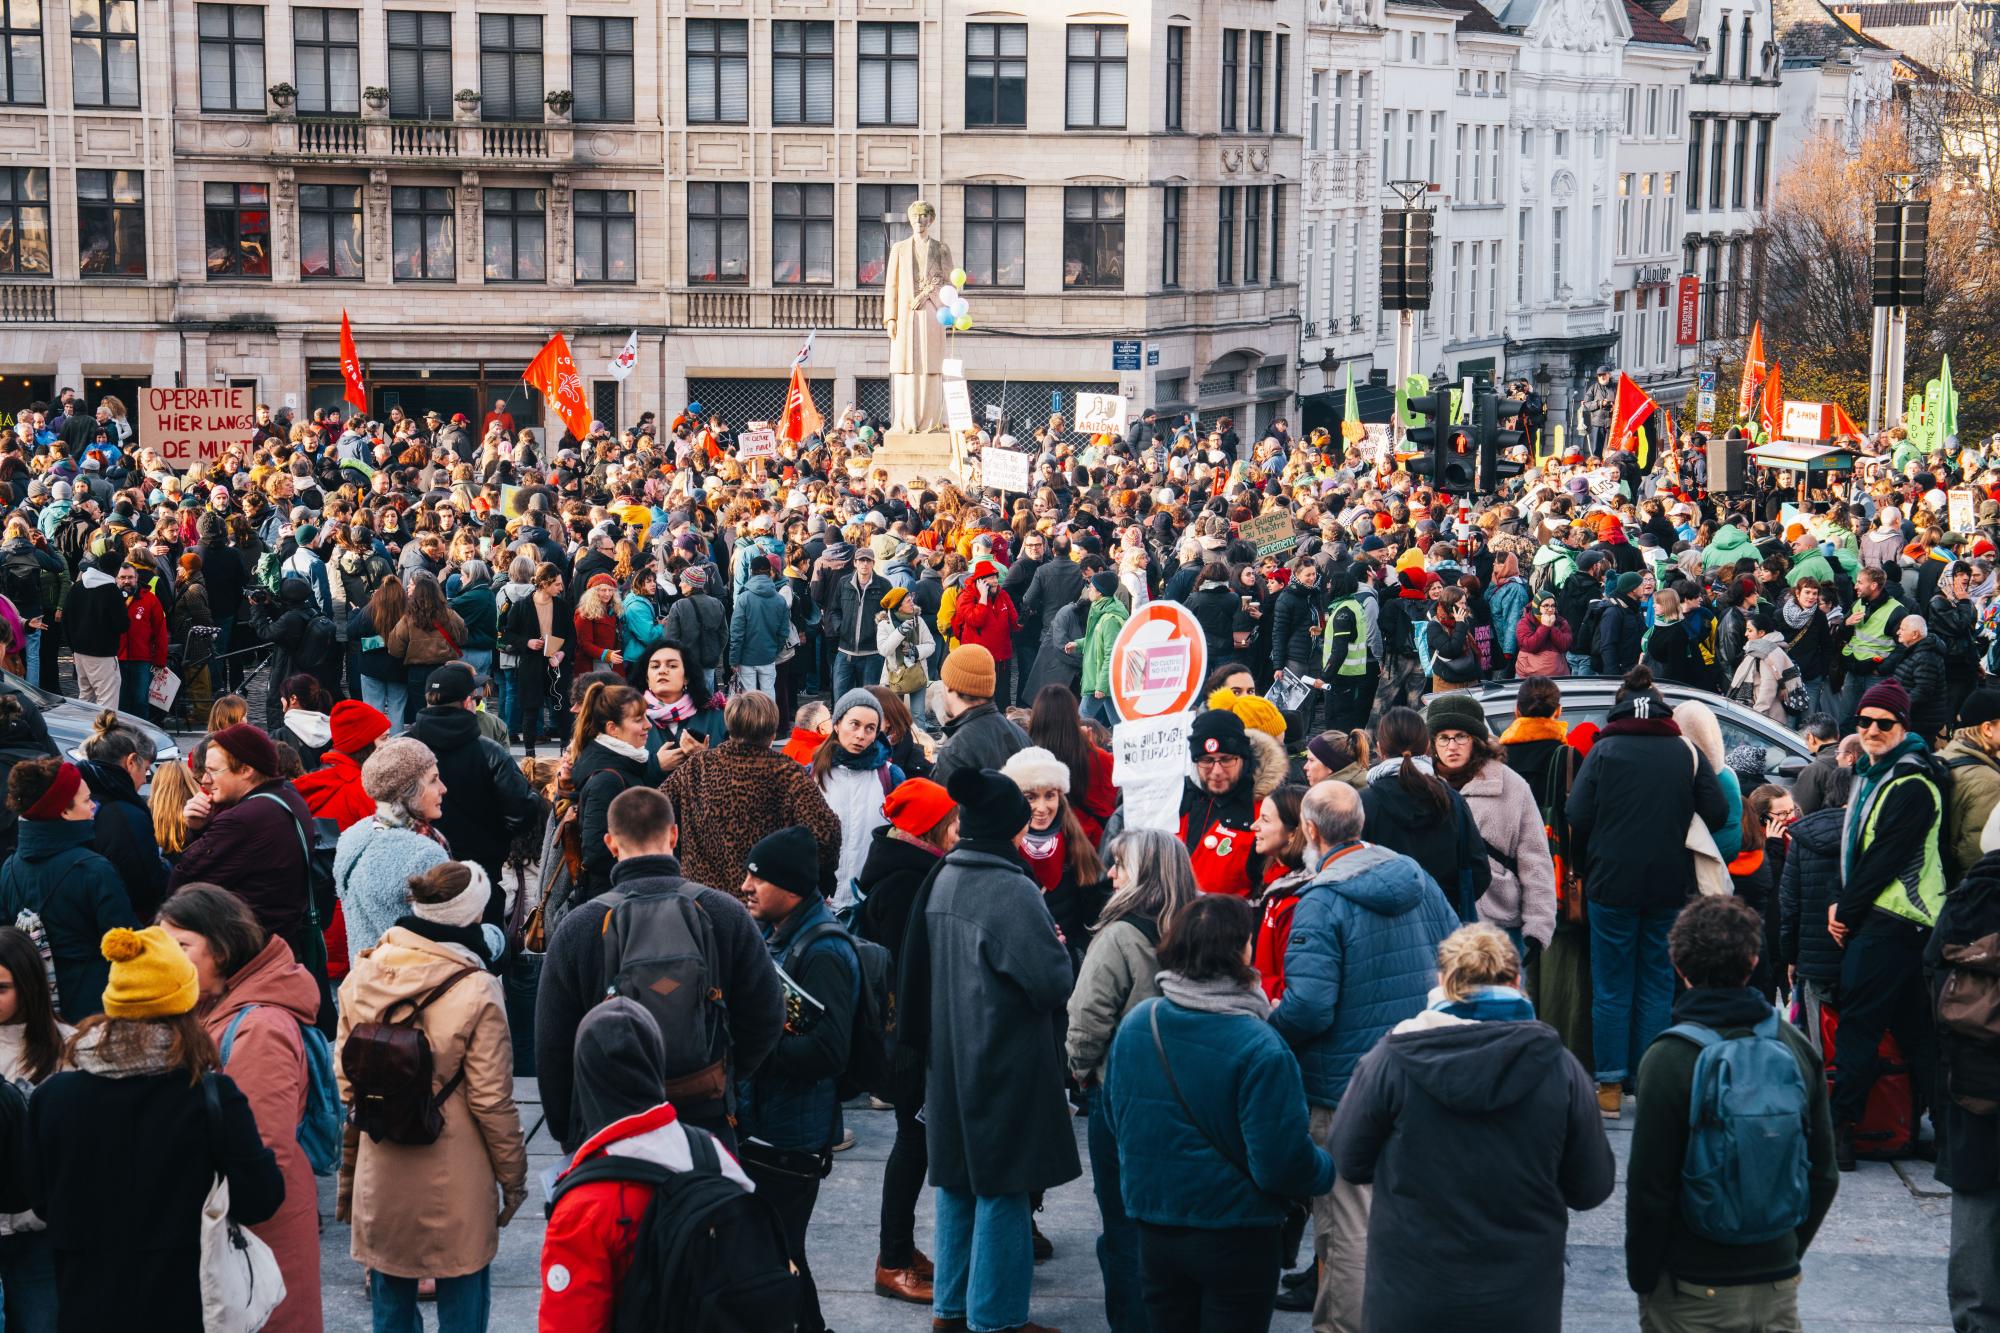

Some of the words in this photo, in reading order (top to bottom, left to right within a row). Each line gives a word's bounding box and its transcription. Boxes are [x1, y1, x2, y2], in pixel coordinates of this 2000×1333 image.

[208, 415, 254, 431] LANGS
[1079, 421, 1120, 433] ARIZONA
[163, 440, 191, 458] DE
[1239, 522, 1252, 532] Les
[1257, 536, 1296, 556] vernement
